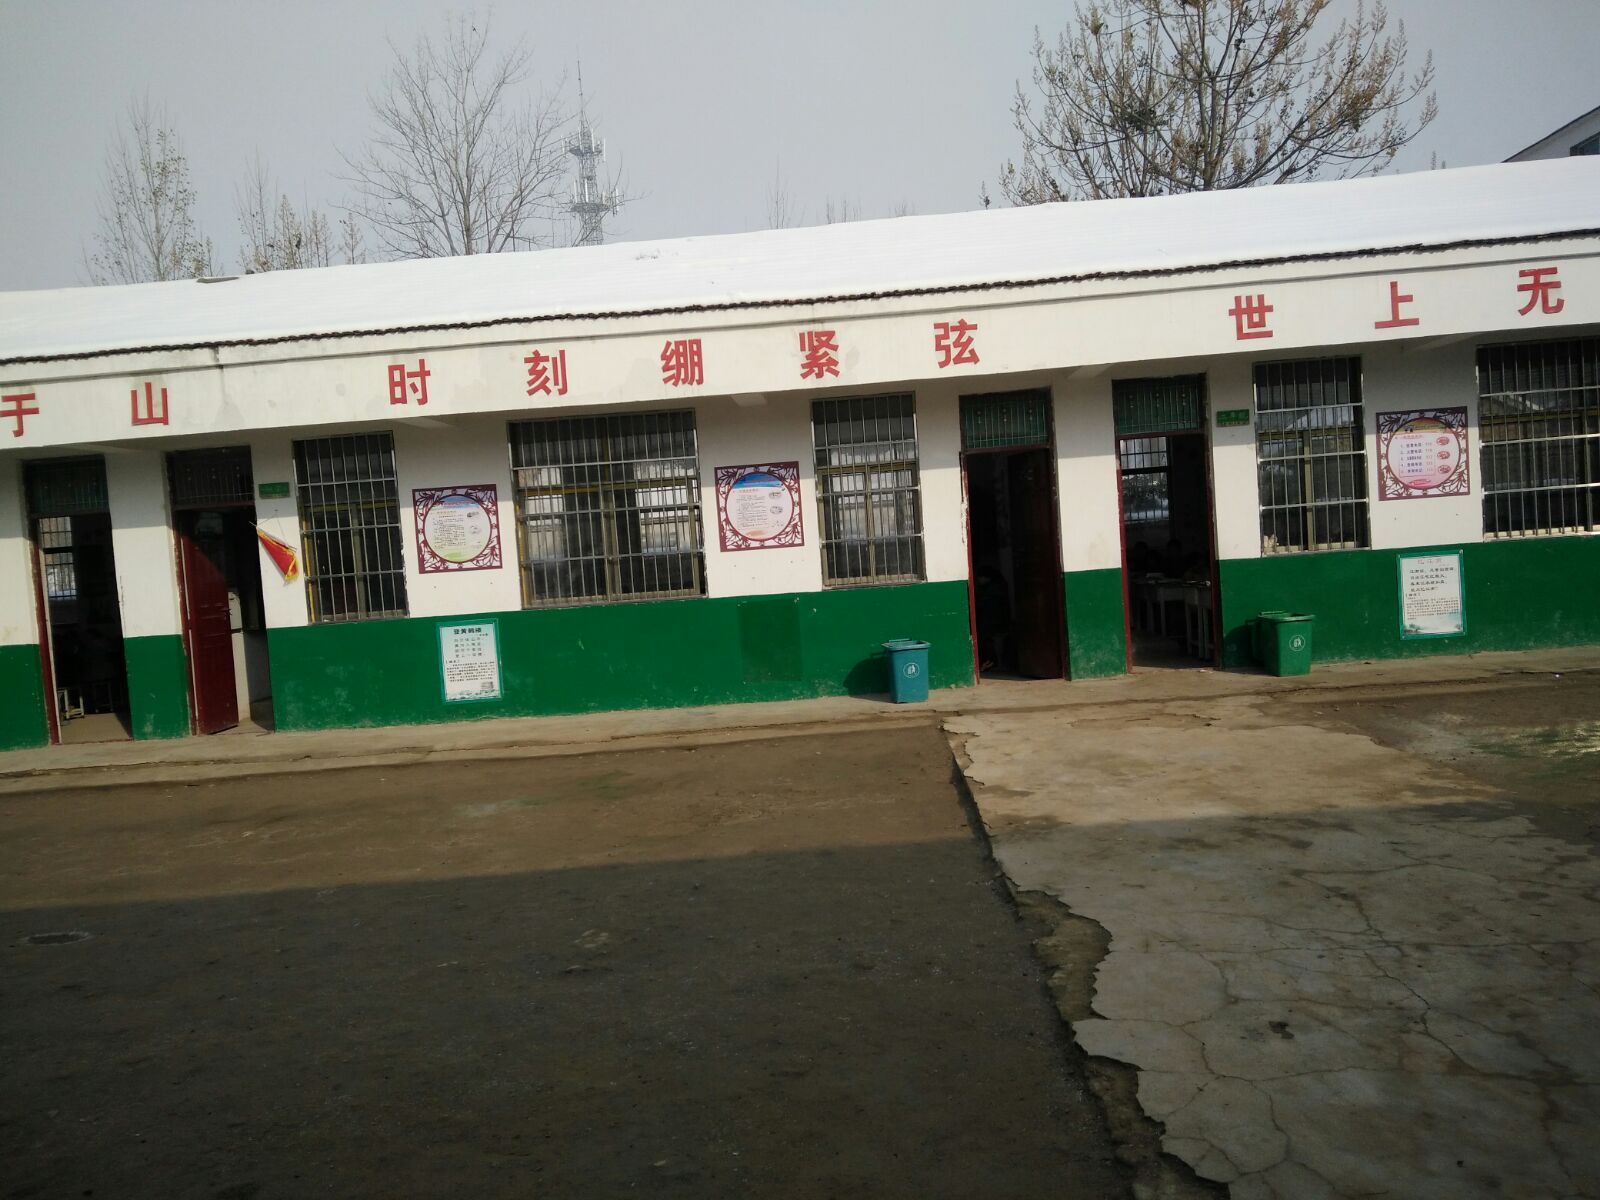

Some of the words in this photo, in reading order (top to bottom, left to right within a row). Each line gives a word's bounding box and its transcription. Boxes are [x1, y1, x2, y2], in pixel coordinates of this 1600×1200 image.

[1229, 267, 1564, 340] 世上无
[387, 318, 979, 406] 时刻绷紧弦
